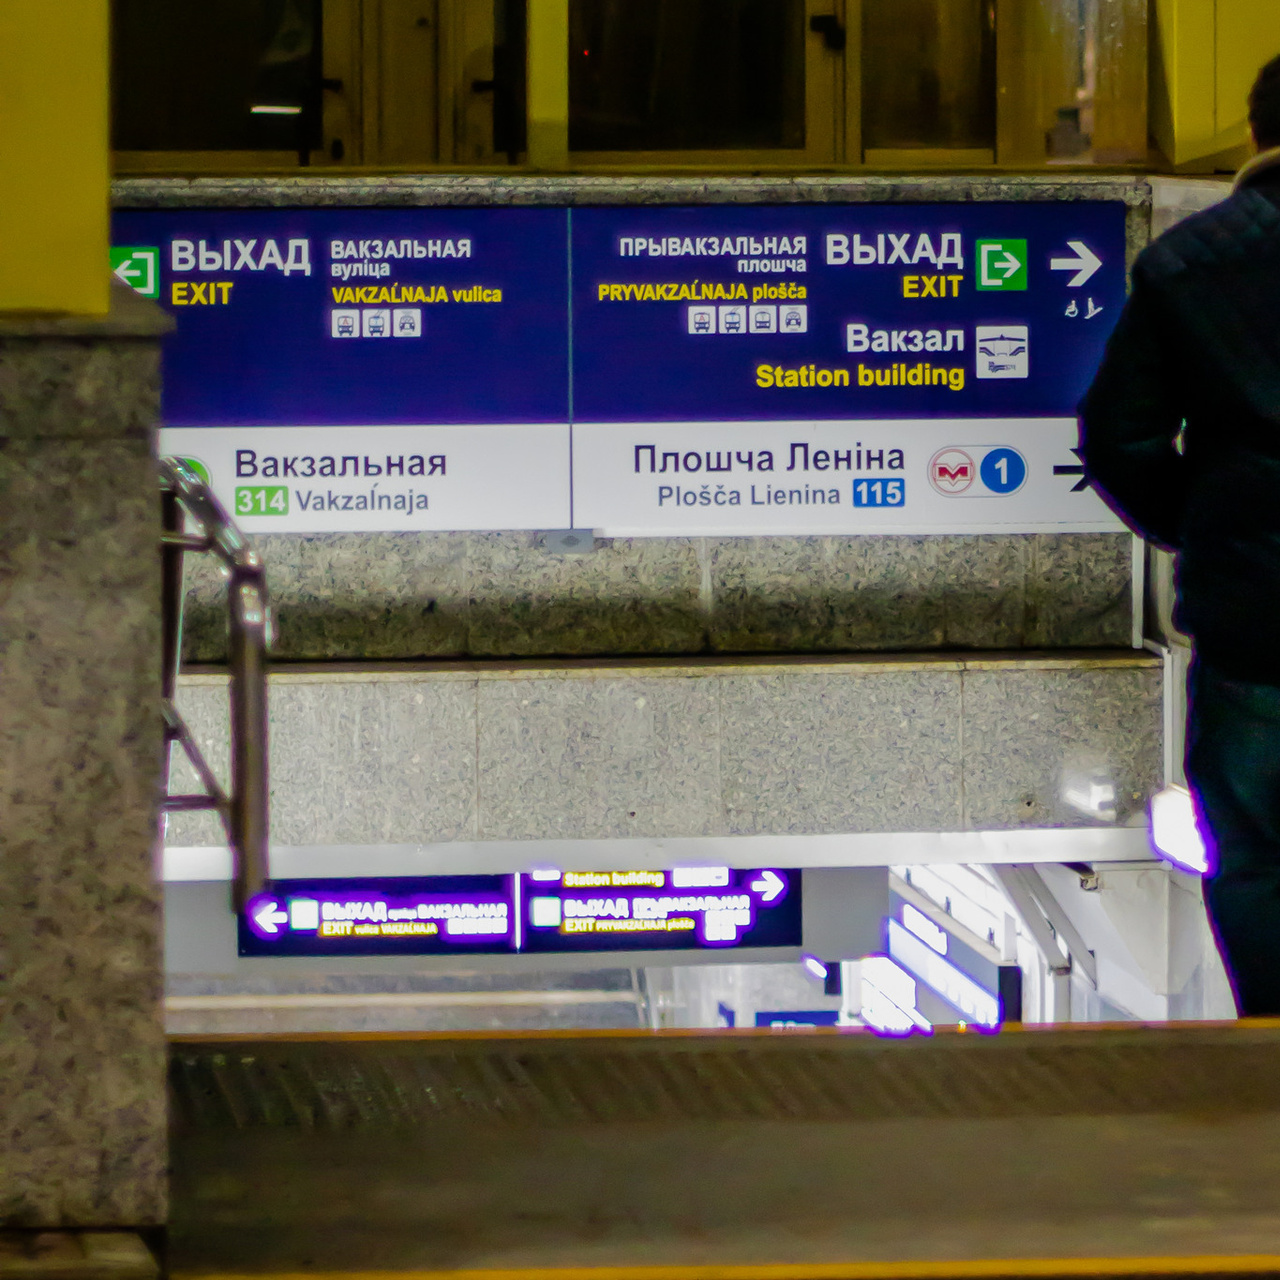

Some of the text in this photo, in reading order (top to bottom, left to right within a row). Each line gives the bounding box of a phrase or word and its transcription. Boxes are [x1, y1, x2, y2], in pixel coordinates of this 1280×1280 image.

[171, 238, 311, 276] ВЫХАД
[330, 239, 472, 259] ВАКЗАЛЬНАЯ
[619, 236, 807, 257] ПРЫВАКЗАЛЬНАЯ
[826, 233, 964, 270] ВЫХАД
[331, 259, 391, 281] вуліца
[737, 259, 807, 273] плошча
[171, 282, 234, 305] EXIT
[452, 285, 502, 303] vulica
[752, 282, 807, 303] plošča
[902, 275, 964, 298] EXIT
[846, 323, 964, 353] Вакзал
[756, 363, 965, 391] Station building
[235, 449, 447, 478] Вакзальная
[634, 442, 905, 473] Плошча Леніна
[994, 458, 1008, 485] 1
[238, 489, 286, 513] 314
[658, 481, 903, 507] Plošča Lienina 115
[564, 871, 665, 888] Station building
[322, 901, 388, 923] ВЫХАД
[564, 897, 630, 919] ВЫХАД
[321, 921, 355, 937] EXIT
[564, 917, 596, 932] EXIT
